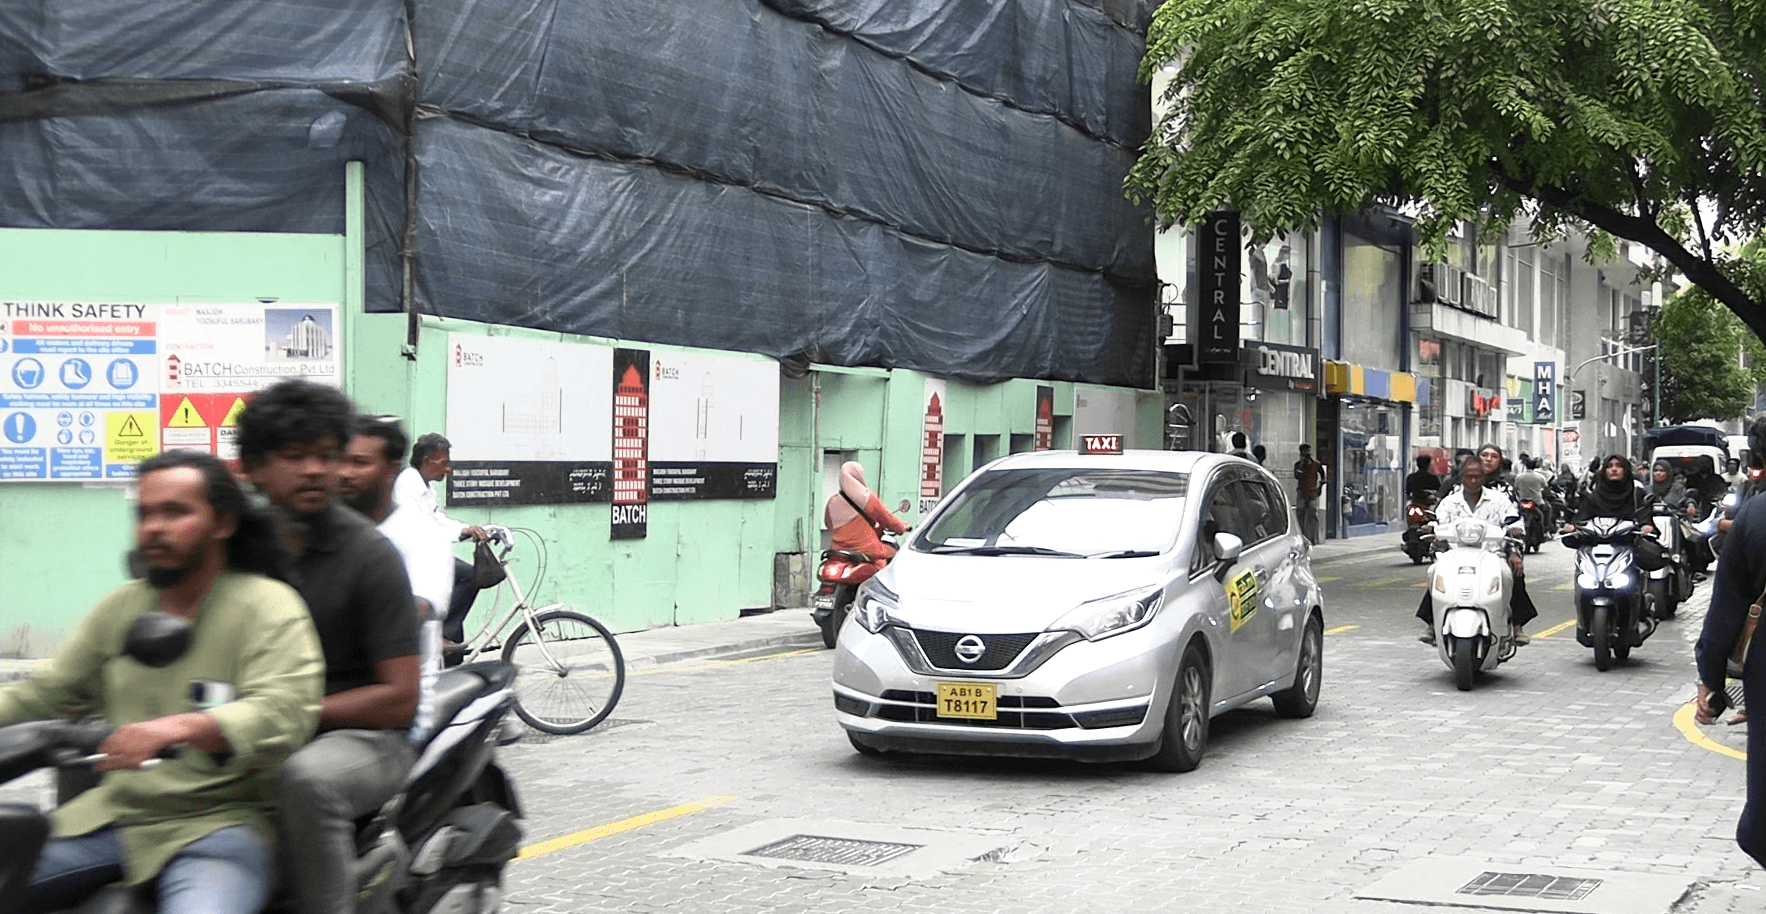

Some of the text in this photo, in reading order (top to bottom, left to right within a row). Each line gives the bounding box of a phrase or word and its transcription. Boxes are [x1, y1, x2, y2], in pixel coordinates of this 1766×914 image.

[1213, 218, 1229, 340] CENTRAL
[3, 302, 146, 319] THINK SAFETY
[29, 323, 44, 333] No
[113, 324, 140, 335] entry
[463, 352, 483, 363] BATCH
[1257, 345, 1315, 379] CENTRAL
[184, 362, 335, 376] BATCH Construction Pvt Ltd
[1537, 366, 1552, 411] MHA
[1085, 437, 1117, 450] TAXI
[612, 505, 646, 525] BATCH
[944, 699, 988, 714] T8117
